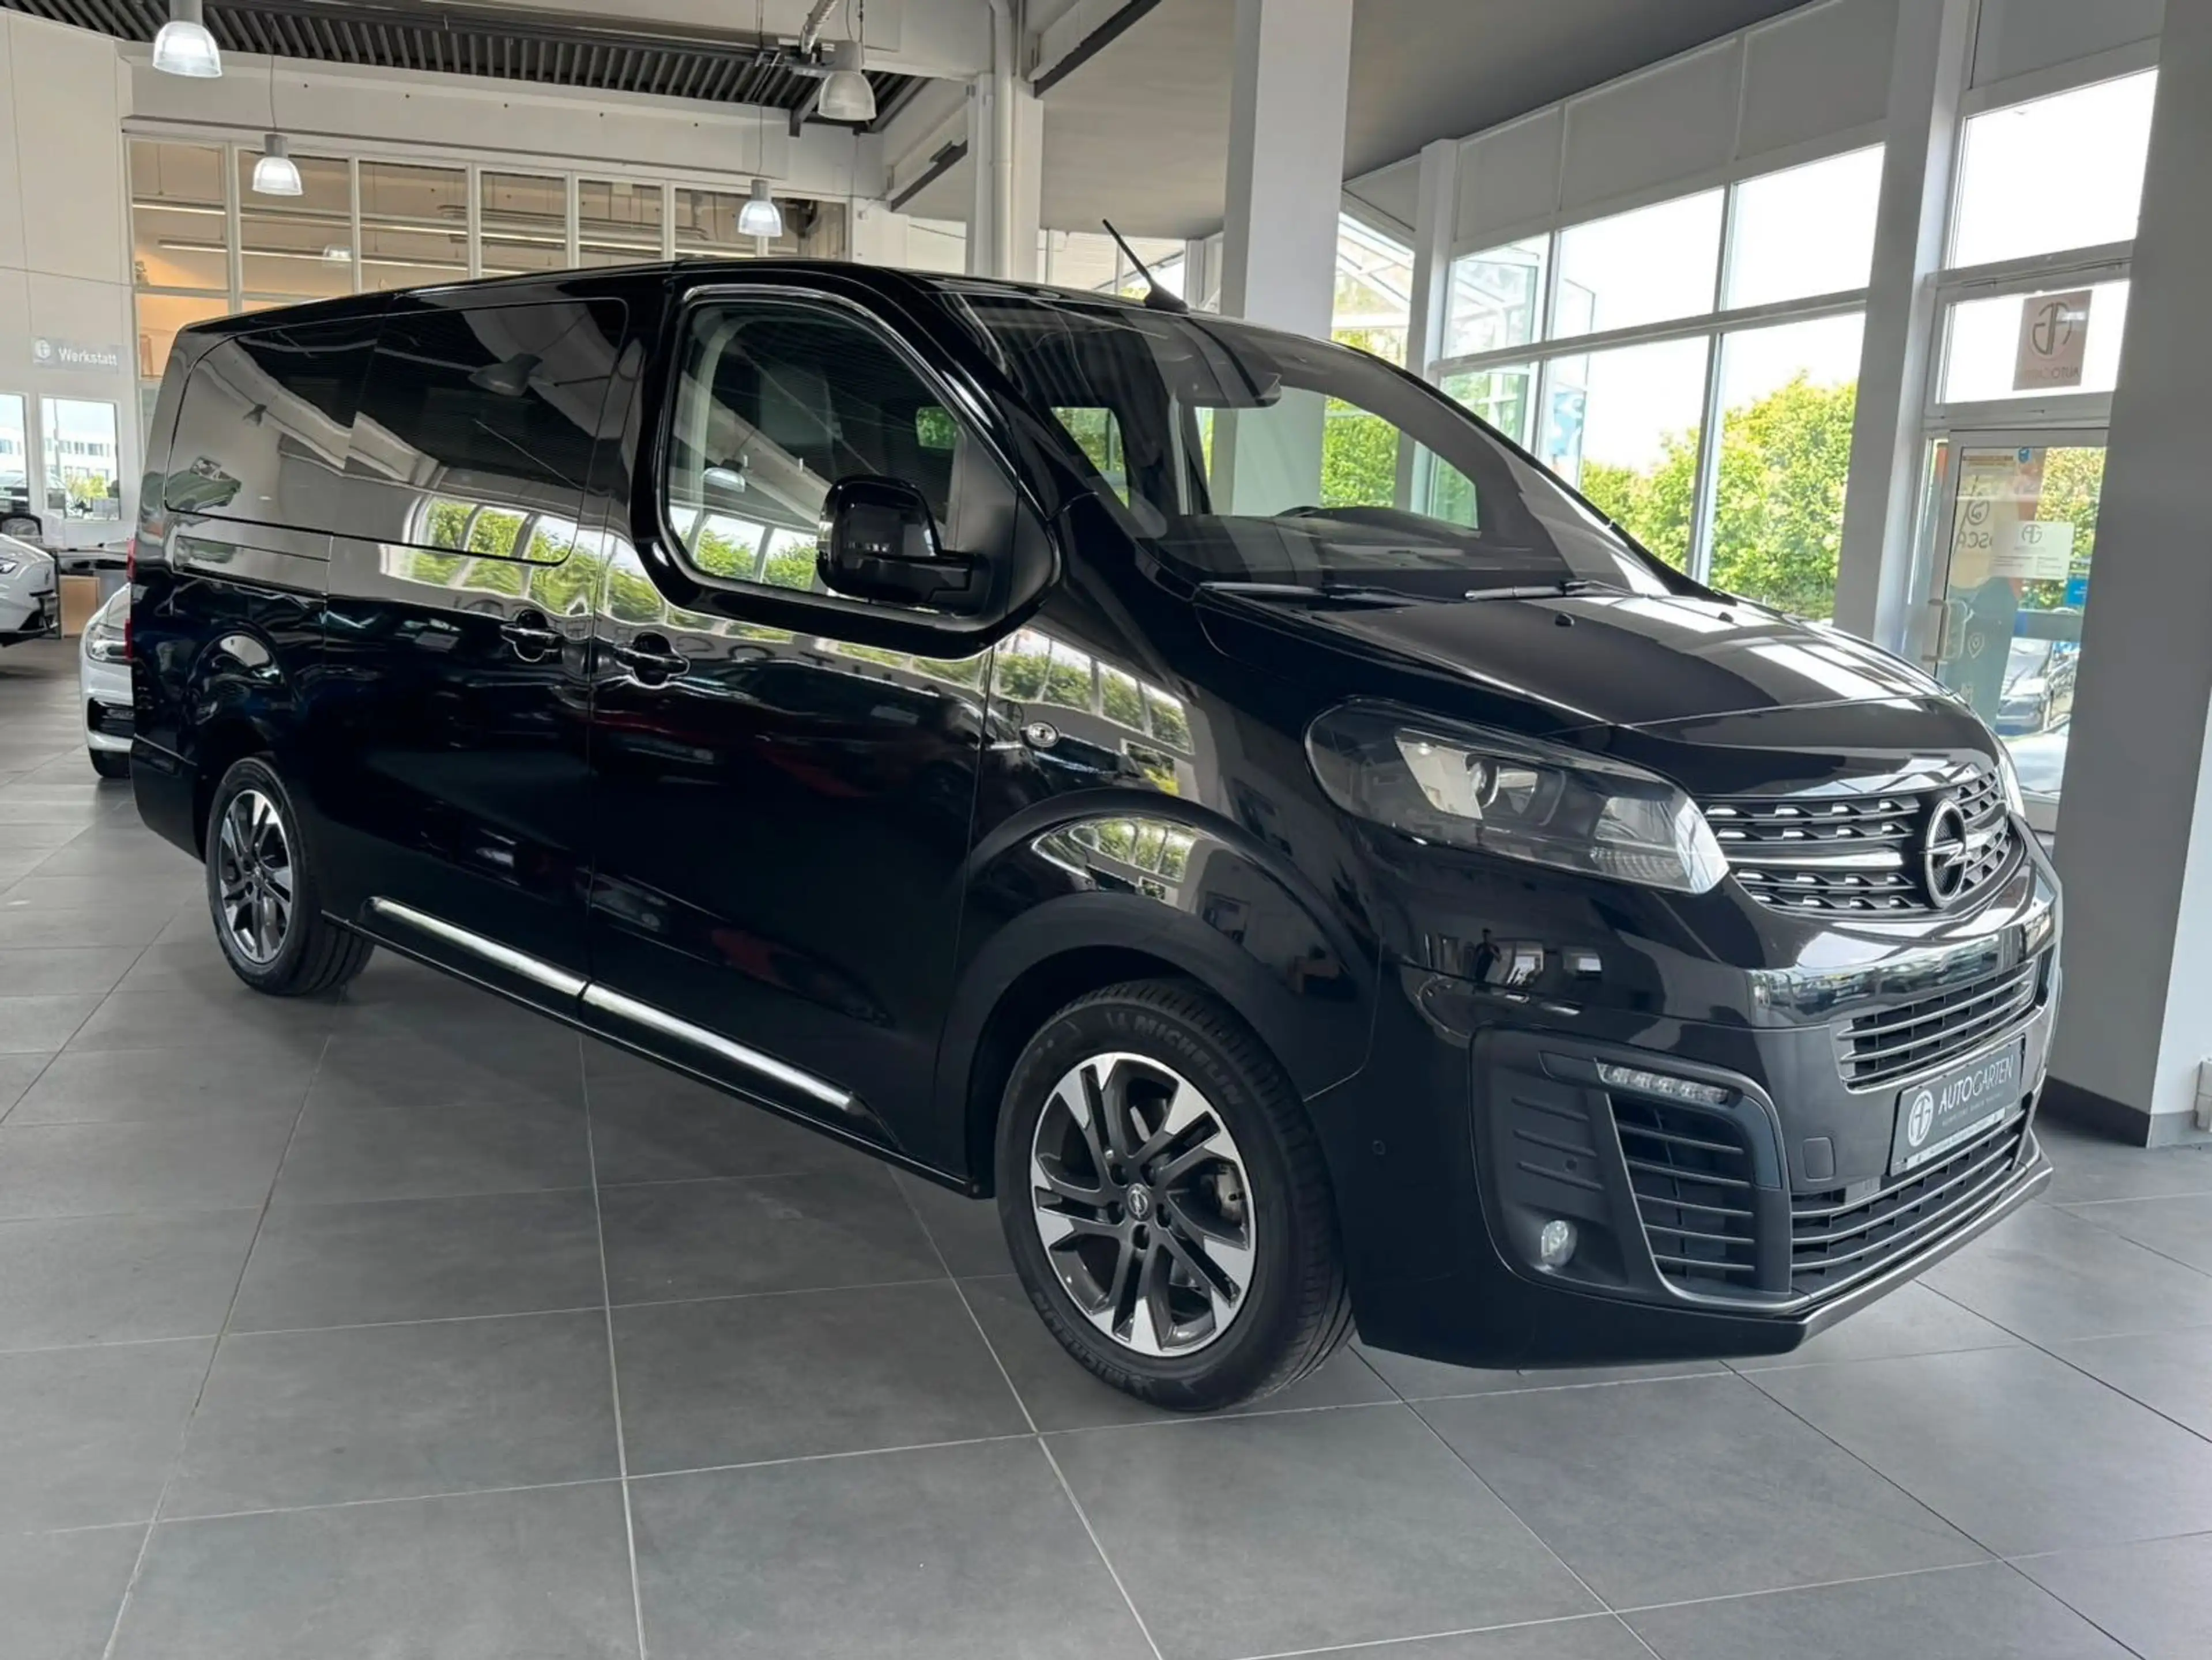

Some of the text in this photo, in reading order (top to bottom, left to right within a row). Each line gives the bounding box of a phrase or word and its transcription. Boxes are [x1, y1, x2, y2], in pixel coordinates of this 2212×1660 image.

[58, 346, 118, 366] Werkstatt
[1134, 1014, 1245, 1105] MICHELIN
[1938, 1054, 2014, 1116] AUTOGARTEN
